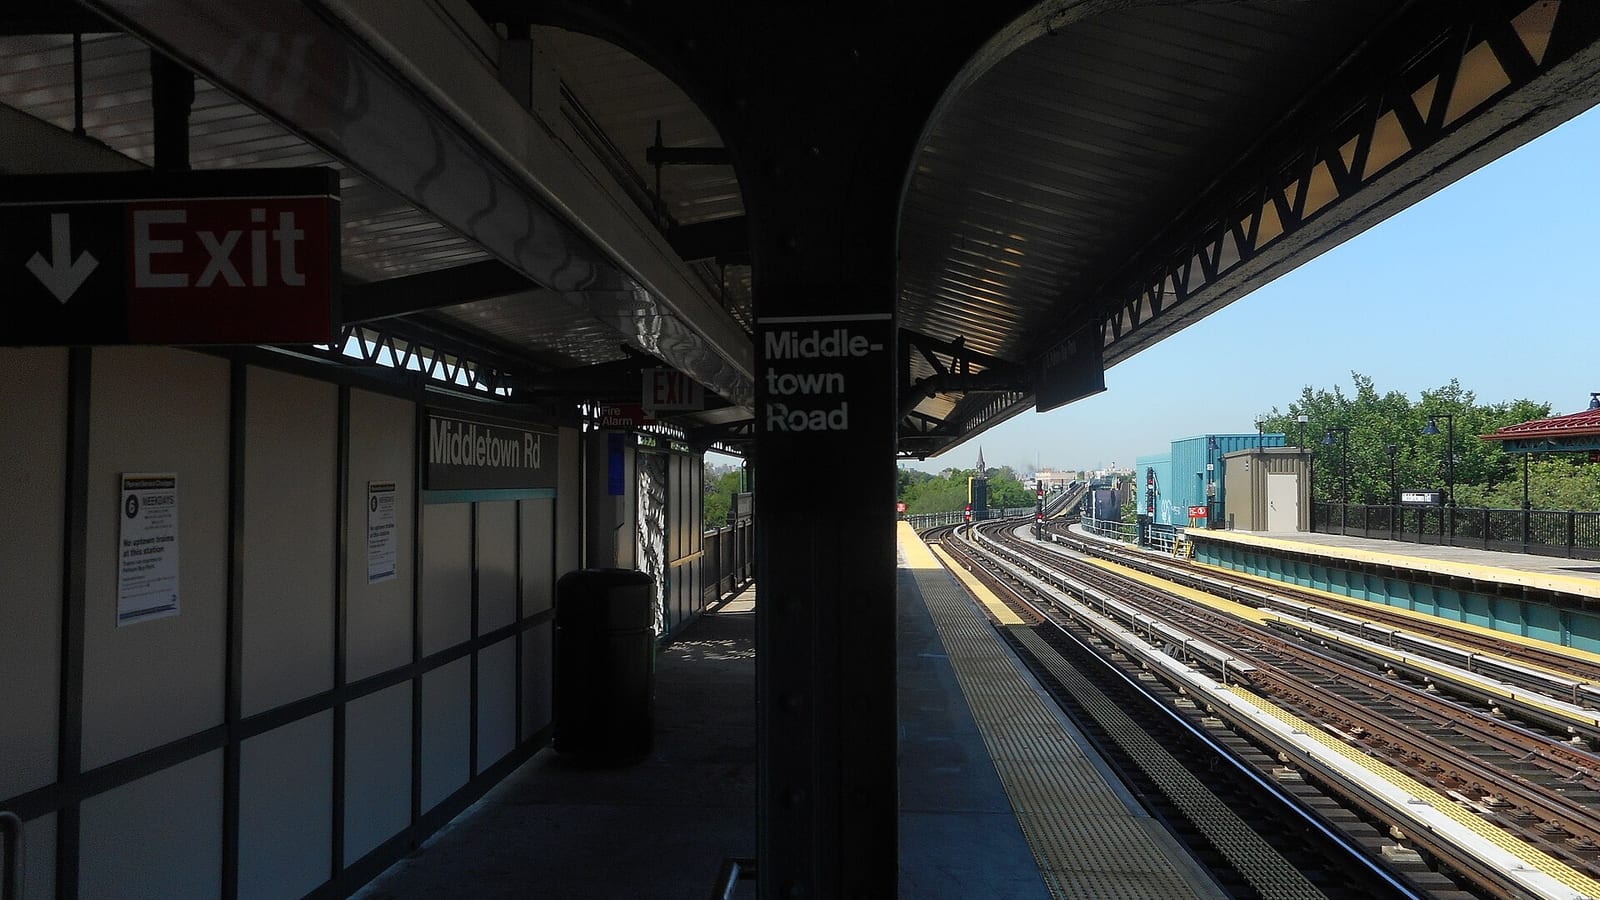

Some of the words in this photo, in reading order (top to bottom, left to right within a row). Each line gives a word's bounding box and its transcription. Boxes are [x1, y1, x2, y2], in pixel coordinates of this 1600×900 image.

[133, 208, 305, 288] Exit
[765, 328, 883, 359] Middle-
[766, 367, 845, 395] town
[601, 406, 621, 416] Fire
[602, 417, 633, 427] Alarm
[766, 401, 848, 432] Road
[429, 418, 519, 468] Middletown
[524, 432, 541, 469] Rd
[143, 546, 164, 555] station
